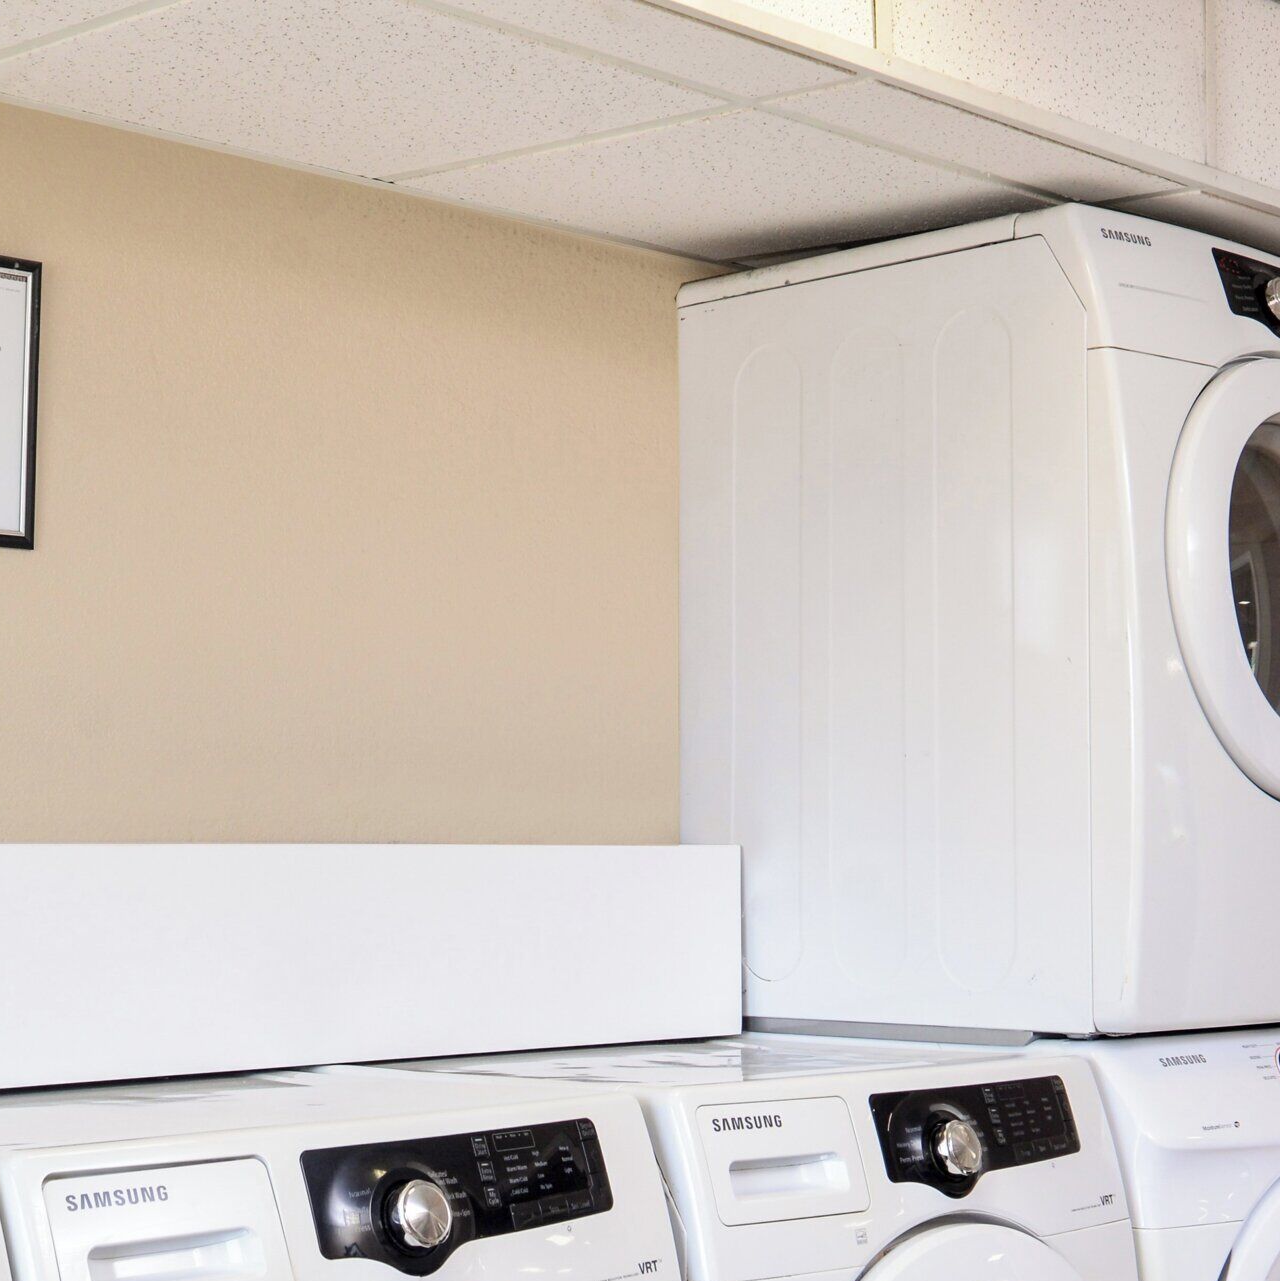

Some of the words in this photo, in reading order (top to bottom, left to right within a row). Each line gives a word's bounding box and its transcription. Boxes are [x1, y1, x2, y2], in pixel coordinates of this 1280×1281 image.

[1101, 228, 1152, 247] SAMSUNG
[1159, 1054, 1207, 1068] SAMSUNG
[712, 1115, 783, 1132] SAMSUNG
[65, 1185, 168, 1212] SAMSUNG
[1100, 1194, 1113, 1206] VRT
[638, 1259, 658, 1275] VRT
